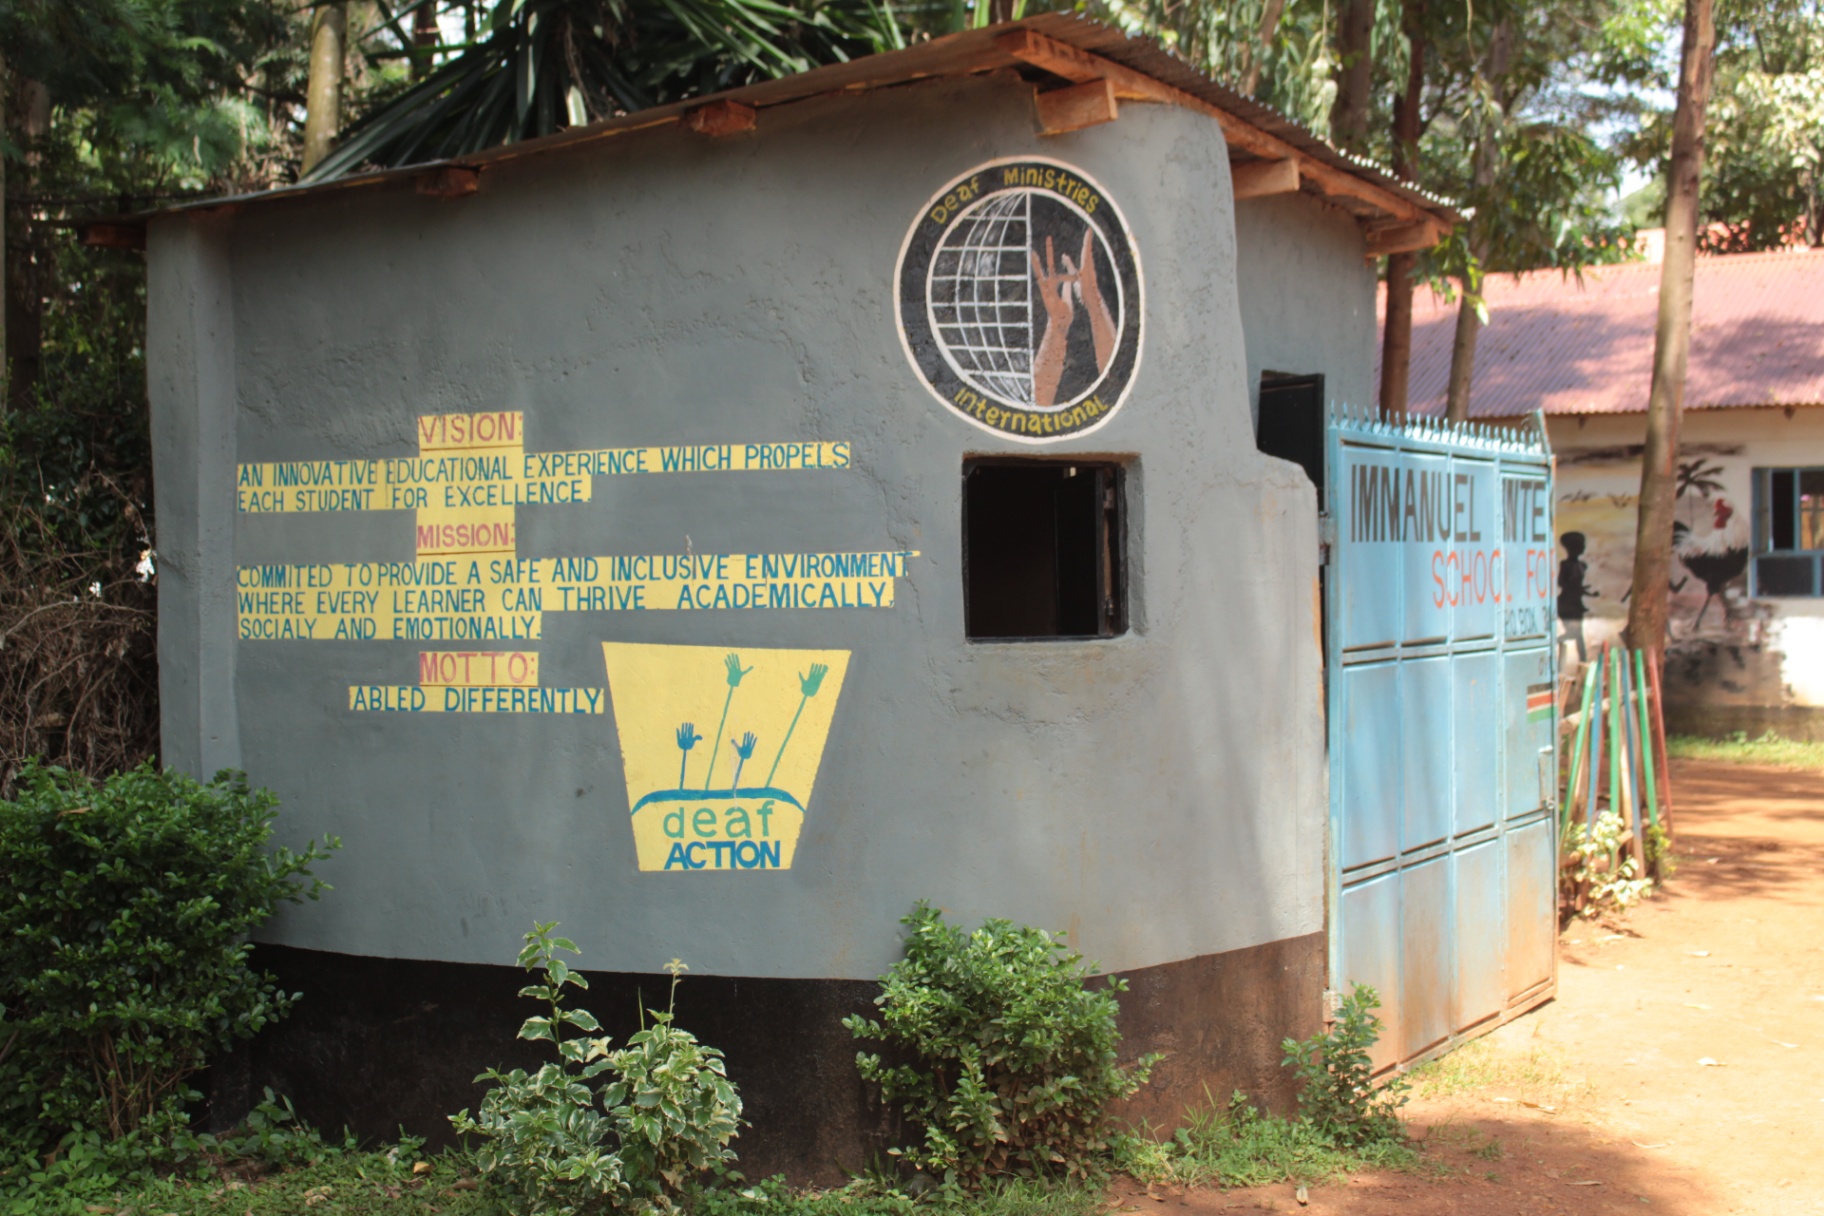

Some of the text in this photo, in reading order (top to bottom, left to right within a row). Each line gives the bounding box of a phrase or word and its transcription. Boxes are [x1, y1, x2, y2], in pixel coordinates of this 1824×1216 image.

[930, 166, 1099, 225] Deaf Ministries
[418, 412, 522, 444] VISION:
[239, 443, 849, 487] AN INNOVATIVE EDUCATIONAL EXPERIENCE WHICH PROPELS
[238, 479, 591, 513] EACH STUDENT FOR EXCELLENCE.
[1502, 478, 1553, 542] INTE
[416, 522, 515, 549] MISSION:
[236, 551, 914, 589] COMMITED TO PROVIDE A SAFE AND INCLUSIVE ENVIRONMENT
[238, 582, 895, 615] WHERE EVERY LEARNER CAN THRIVE ACADEMICALLY,
[240, 617, 317, 640] SOCIALY
[334, 617, 377, 640] AND
[420, 652, 535, 684] MOTTO:
[353, 686, 605, 714] ABLED DIFFERENTLY
[662, 800, 776, 839] deaf
[663, 839, 781, 871] ACTION
